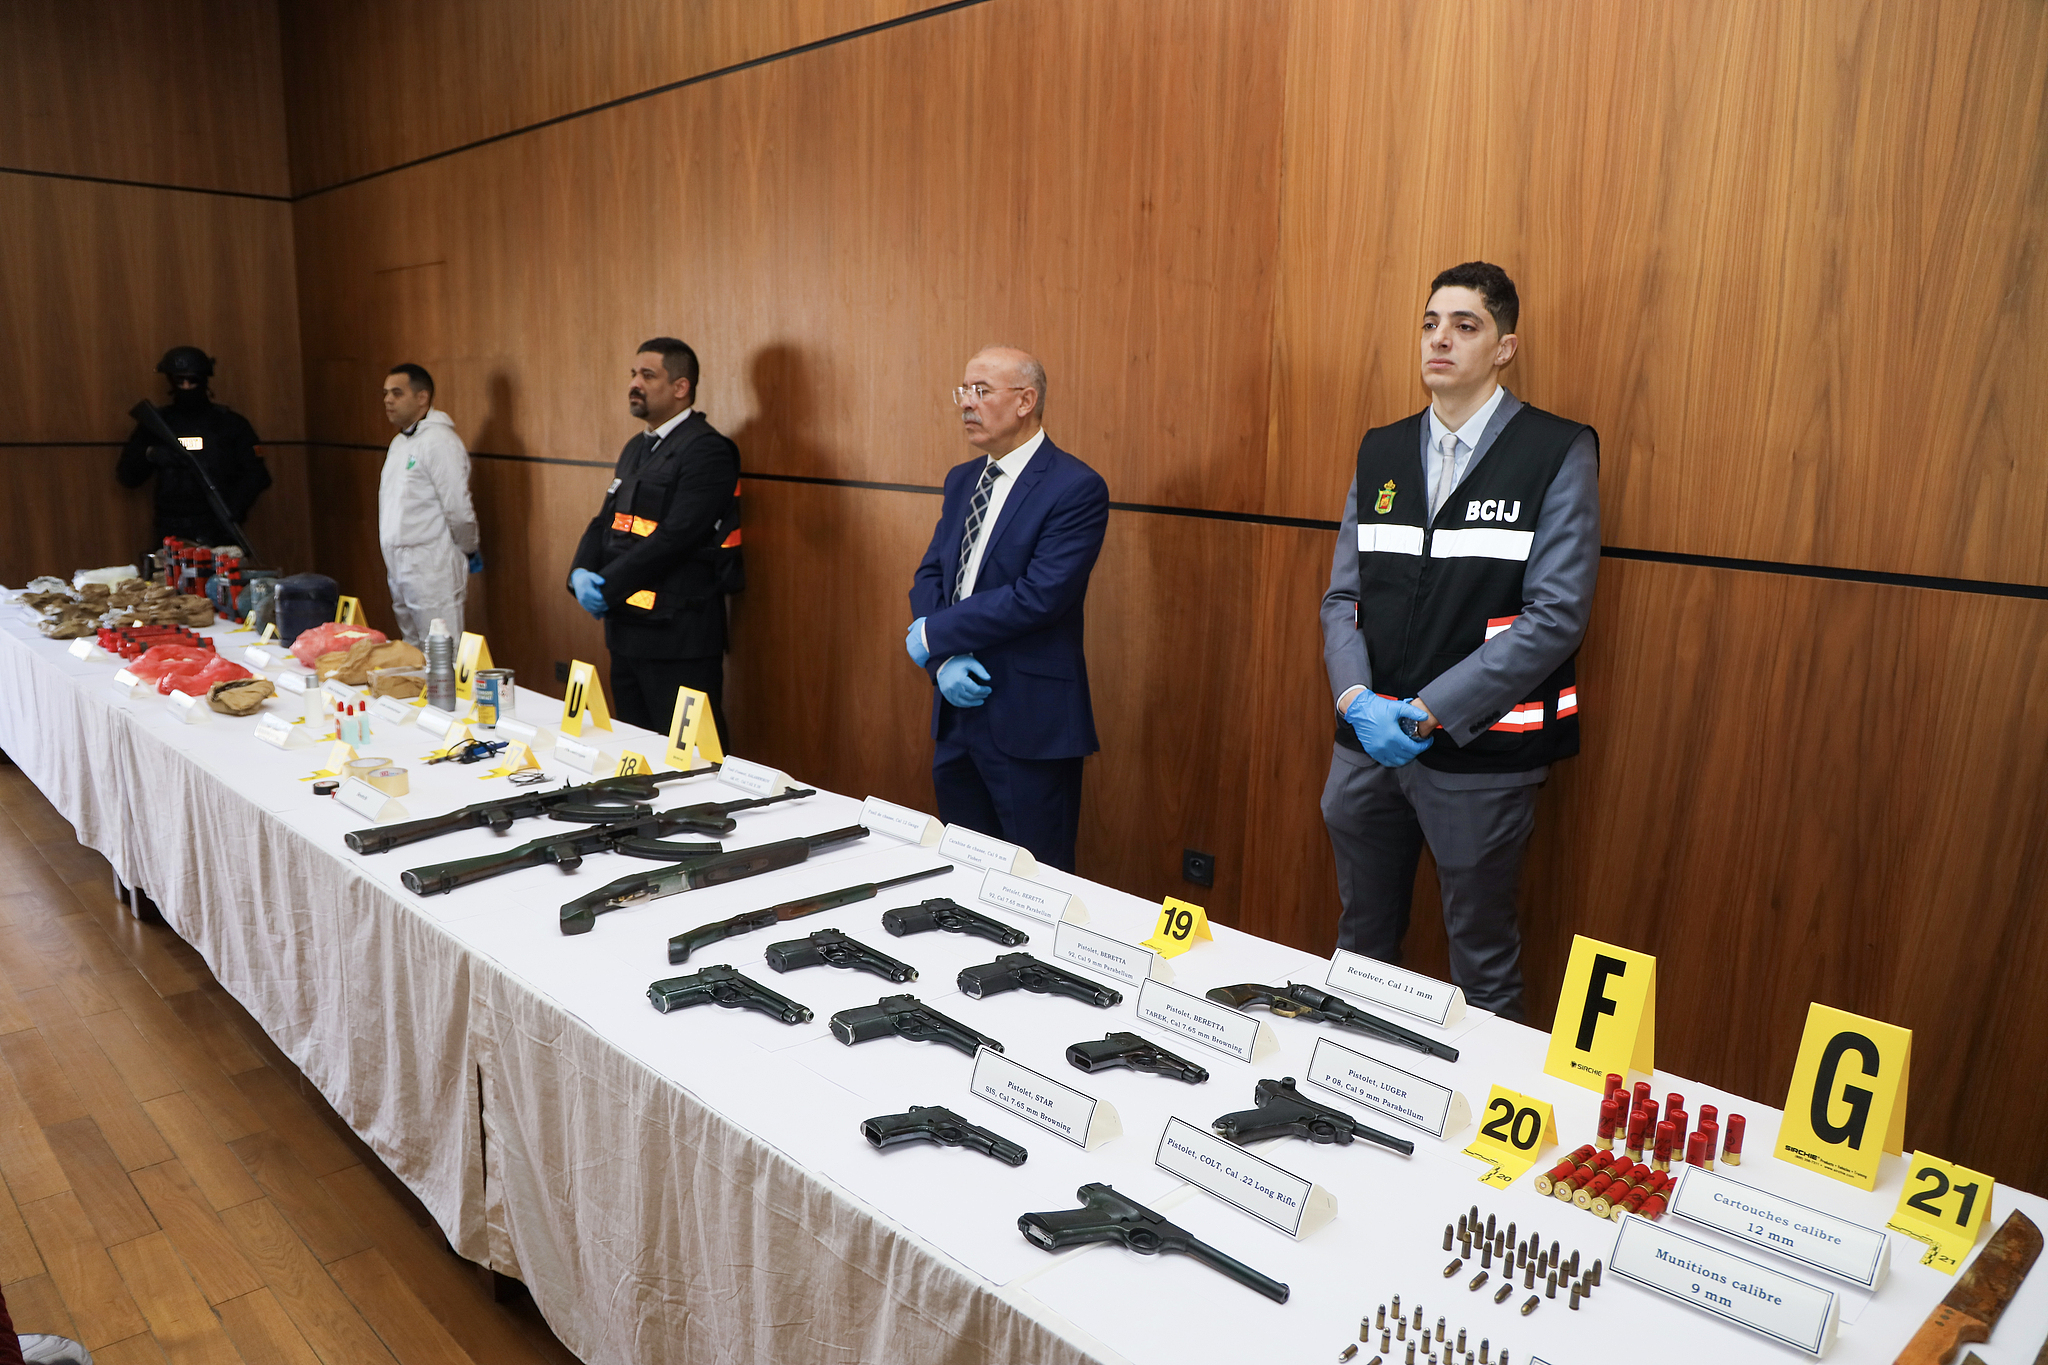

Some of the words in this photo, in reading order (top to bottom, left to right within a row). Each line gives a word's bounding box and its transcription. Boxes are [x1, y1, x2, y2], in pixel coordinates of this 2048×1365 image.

[1464, 499, 1521, 523] BCIJ
[676, 696, 696, 751] E
[620, 756, 637, 777] 18
[1002, 886, 1021, 897] Pistolet,
[1021, 892, 1045, 905] BERETTA
[1005, 898, 1016, 906] 7.65
[1025, 905, 1052, 918] Parabellum
[1163, 906, 1193, 941] 19
[1067, 951, 1077, 959] 92,
[1077, 954, 1087, 962] Cal
[1092, 960, 1103, 968] mm
[1103, 963, 1134, 979] Parabellum
[1077, 942, 1099, 956] Pistolet,
[1100, 951, 1127, 965] BERETTA
[1347, 966, 1385, 985] Revolver,
[1387, 979, 1402, 990] Cal
[1403, 985, 1414, 994] 11
[1416, 990, 1434, 1001] mm
[1574, 953, 1627, 1053] F
[1145, 1008, 1169, 1024] TAREK,
[1170, 1020, 1181, 1028] Cal
[1182, 1023, 1196, 1034] 7.65
[1197, 1031, 1210, 1040] mm
[1211, 1035, 1243, 1054] Browning
[1166, 1004, 1192, 1020] Pistolet,
[1193, 1014, 1225, 1032] BERETTA
[1348, 1068, 1379, 1088] Pistolet,
[1380, 1082, 1408, 1099] LUGER
[1577, 1063, 1603, 1077] SIRCHIE
[1007, 1080, 1034, 1099] Pistolet,
[1034, 1094, 1054, 1108] STAR
[1332, 1077, 1343, 1088] 08,
[1345, 1083, 1358, 1094] Cal
[1359, 1088, 1365, 1096] 9
[1366, 1093, 1380, 1103] mm
[1382, 1098, 1425, 1122] Parabellum
[1810, 1031, 1881, 1151] G
[985, 1085, 998, 1097] SIS,
[1000, 1092, 1009, 1102] Cal
[1011, 1097, 1025, 1110] 7.65
[1026, 1106, 1039, 1116] mm
[1040, 1112, 1072, 1134] Browning
[1480, 1097, 1542, 1151] 20
[1785, 1144, 1818, 1161] SIRCHIE
[1167, 1137, 1197, 1160] Pistolet,
[1199, 1154, 1223, 1173] COLT,
[1225, 1167, 1239, 1179] Cal
[1239, 1175, 1253, 1186] .22
[1254, 1181, 1275, 1199] Long
[1276, 1192, 1297, 1208] Rifle
[1496, 1173, 1513, 1182] 20
[1906, 1167, 1979, 1228] 21
[1713, 1192, 1790, 1227] Cartouches
[1793, 1222, 1842, 1246] calibre
[1746, 1222, 1764, 1236] 12
[1768, 1231, 1795, 1248] mm
[1938, 1254, 1957, 1266] 21
[1655, 1248, 1728, 1285] Munitions
[1731, 1280, 1783, 1306] calibre
[1691, 1283, 1701, 1294] 9
[1704, 1290, 1733, 1308] mm
